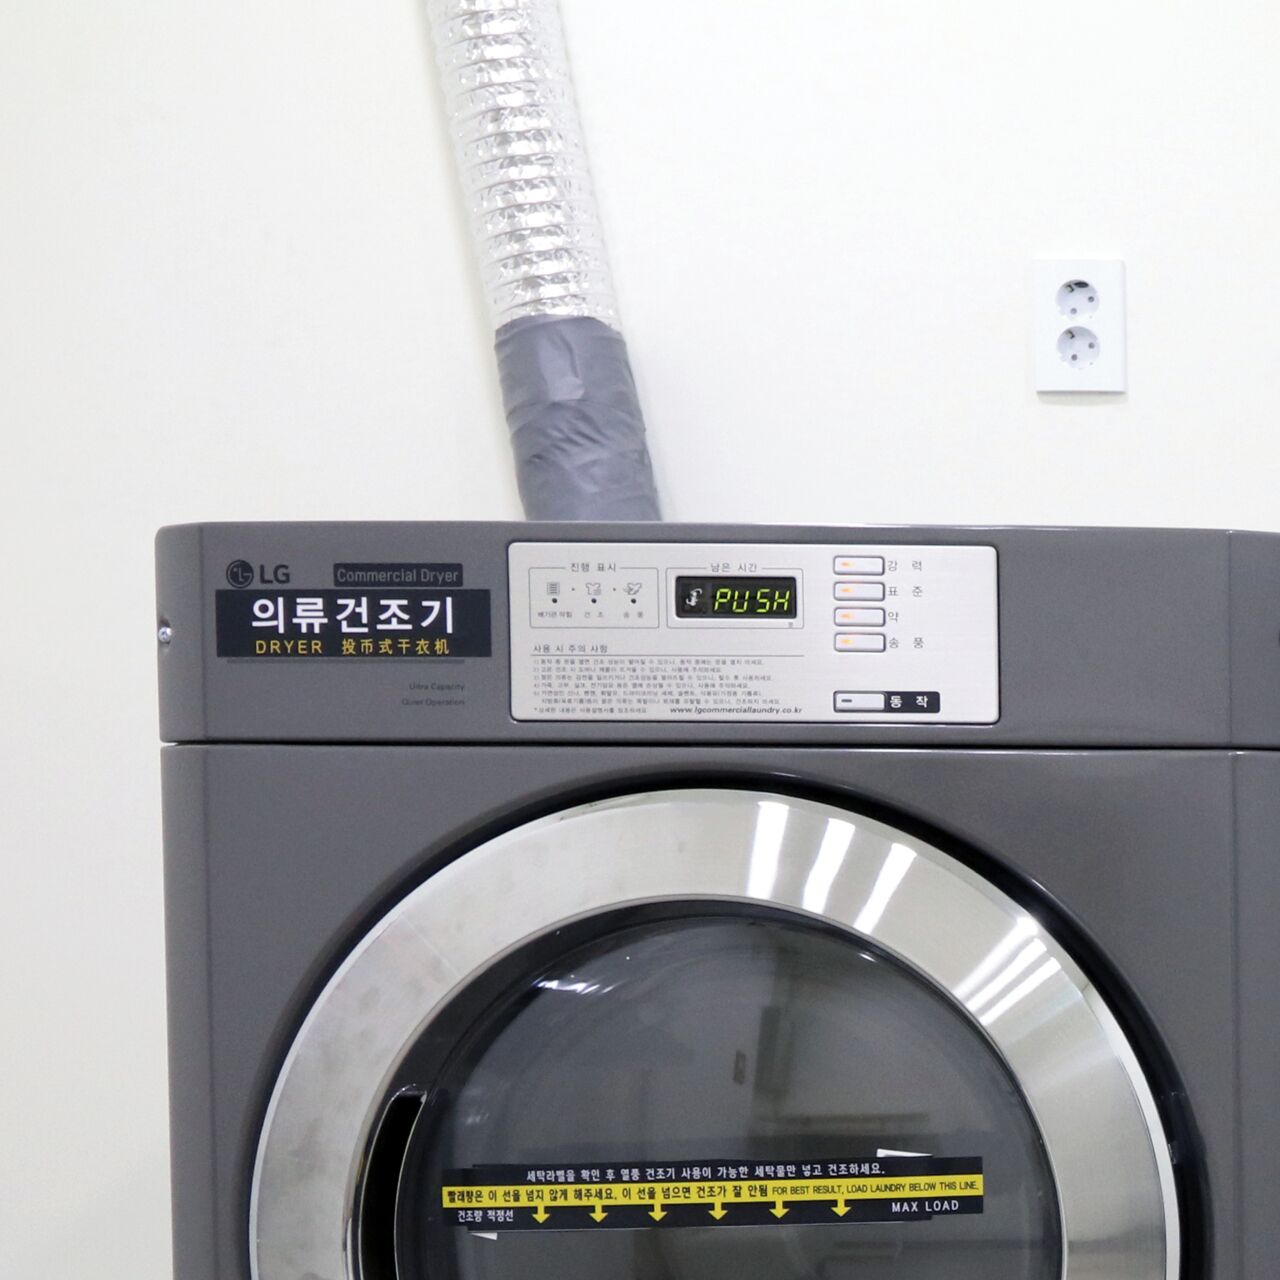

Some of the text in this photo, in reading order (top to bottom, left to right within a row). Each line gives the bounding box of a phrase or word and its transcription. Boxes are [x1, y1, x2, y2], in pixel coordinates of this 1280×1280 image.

[260, 565, 290, 584] LG
[570, 563, 616, 572] 진행 표시
[711, 563, 757, 572] 남은 시간
[337, 567, 458, 586] Commercial Dryer
[714, 588, 790, 613] PUSH
[251, 596, 453, 634] 의류건조기
[888, 611, 899, 623] 약
[256, 640, 323, 654] DRYER
[341, 639, 450, 655] 投币式干衣机
[526, 1169, 575, 1181] 세탁라벨을
[580, 1169, 599, 1181] 확인
[605, 1169, 615, 1181] 후
[620, 1168, 640, 1180] 열풍
[645, 1167, 675, 1179] 건조기
[681, 1166, 711, 1179] 사용이
[717, 1166, 748, 1178] 가능한
[754, 1165, 795, 1177] 세탁물만
[828, 1162, 884, 1175] 건조하세요.
[488, 1190, 496, 1201] 이
[502, 1189, 520, 1202] 선을
[549, 1188, 567, 1201] 않게
[573, 1187, 616, 1200] 해주세요.
[622, 1187, 630, 1199] 이
[637, 1186, 655, 1199] 선을
[696, 1185, 726, 1198] 건조가
[732, 1185, 742, 1197] 잘
[892, 1200, 958, 1212] MAX LOAD
[458, 1209, 513, 1222] 건조량 적정선
